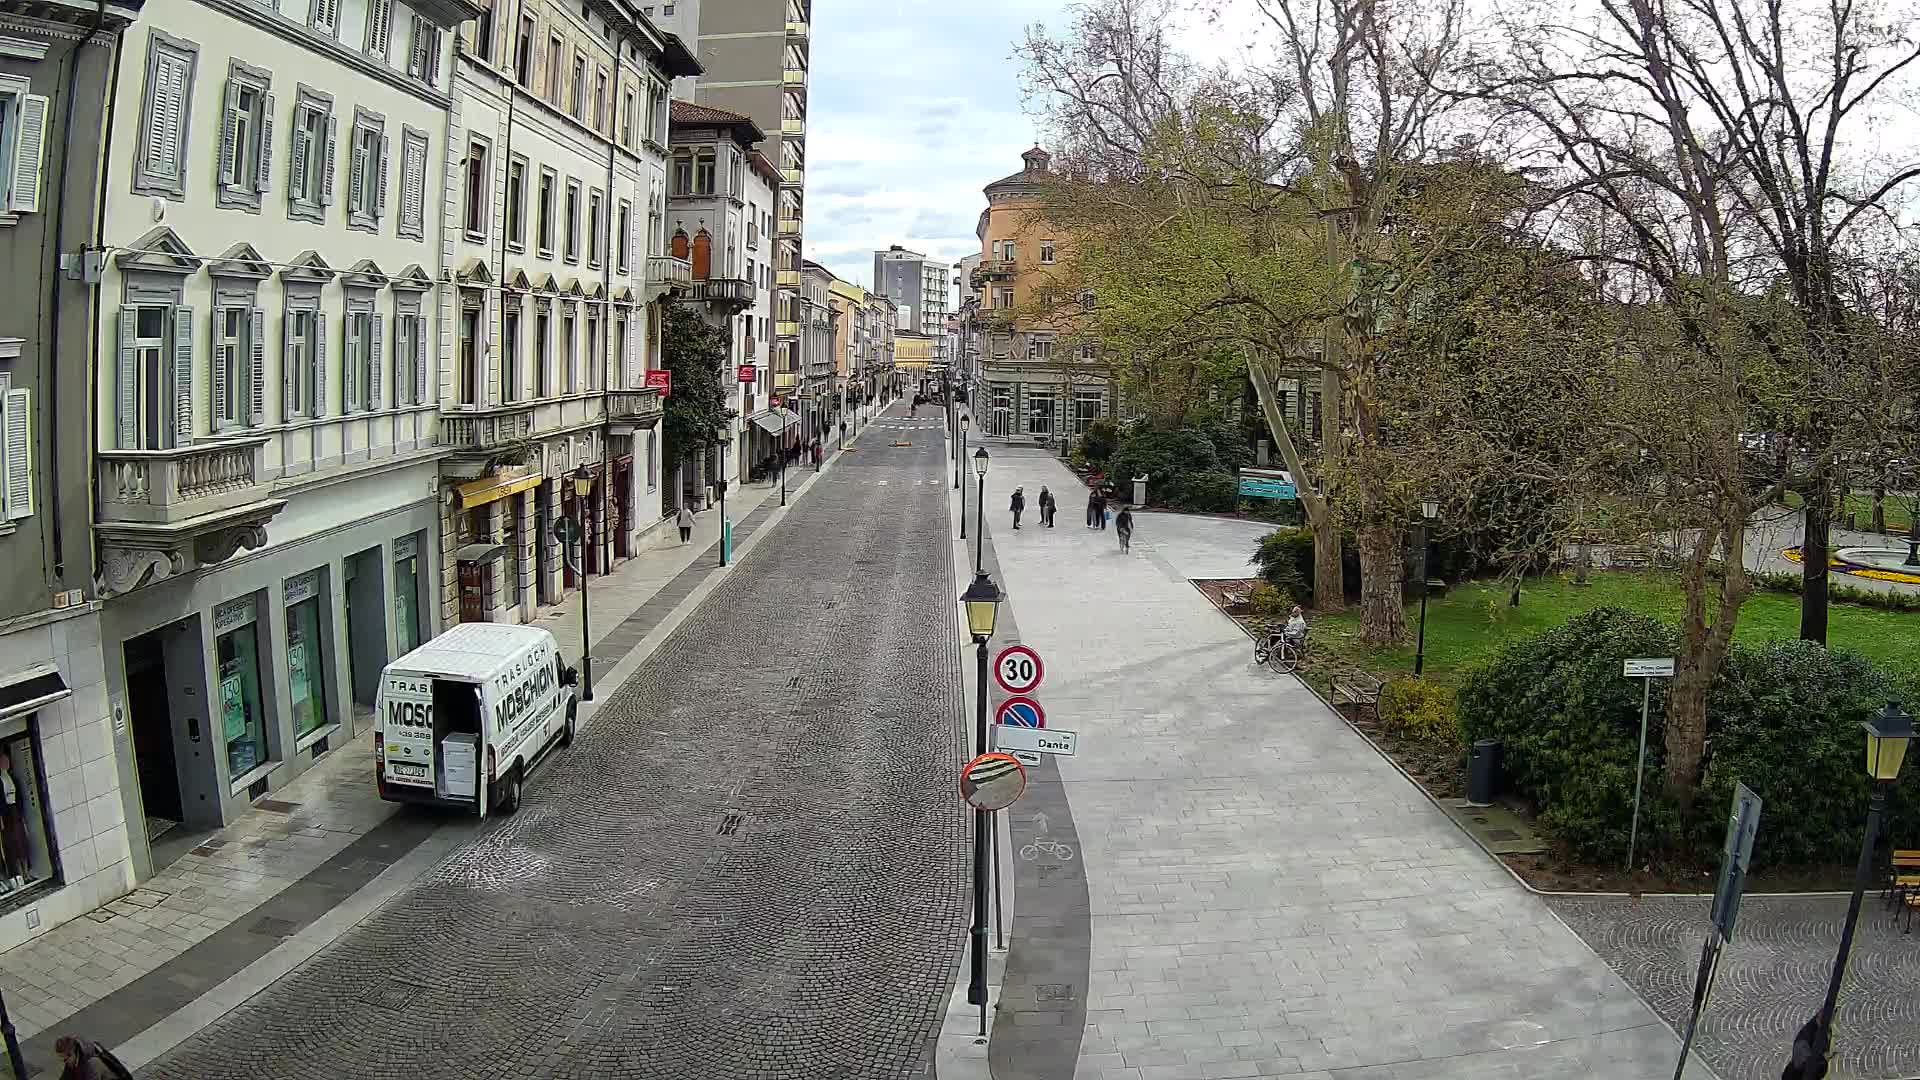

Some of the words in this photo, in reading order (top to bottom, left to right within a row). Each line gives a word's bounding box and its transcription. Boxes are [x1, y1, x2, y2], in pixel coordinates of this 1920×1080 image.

[494, 643, 549, 692] TRASLOCHI
[1005, 659, 1033, 681] 30
[495, 660, 555, 733] MOSCHION
[1038, 739, 1069, 750] Dante
